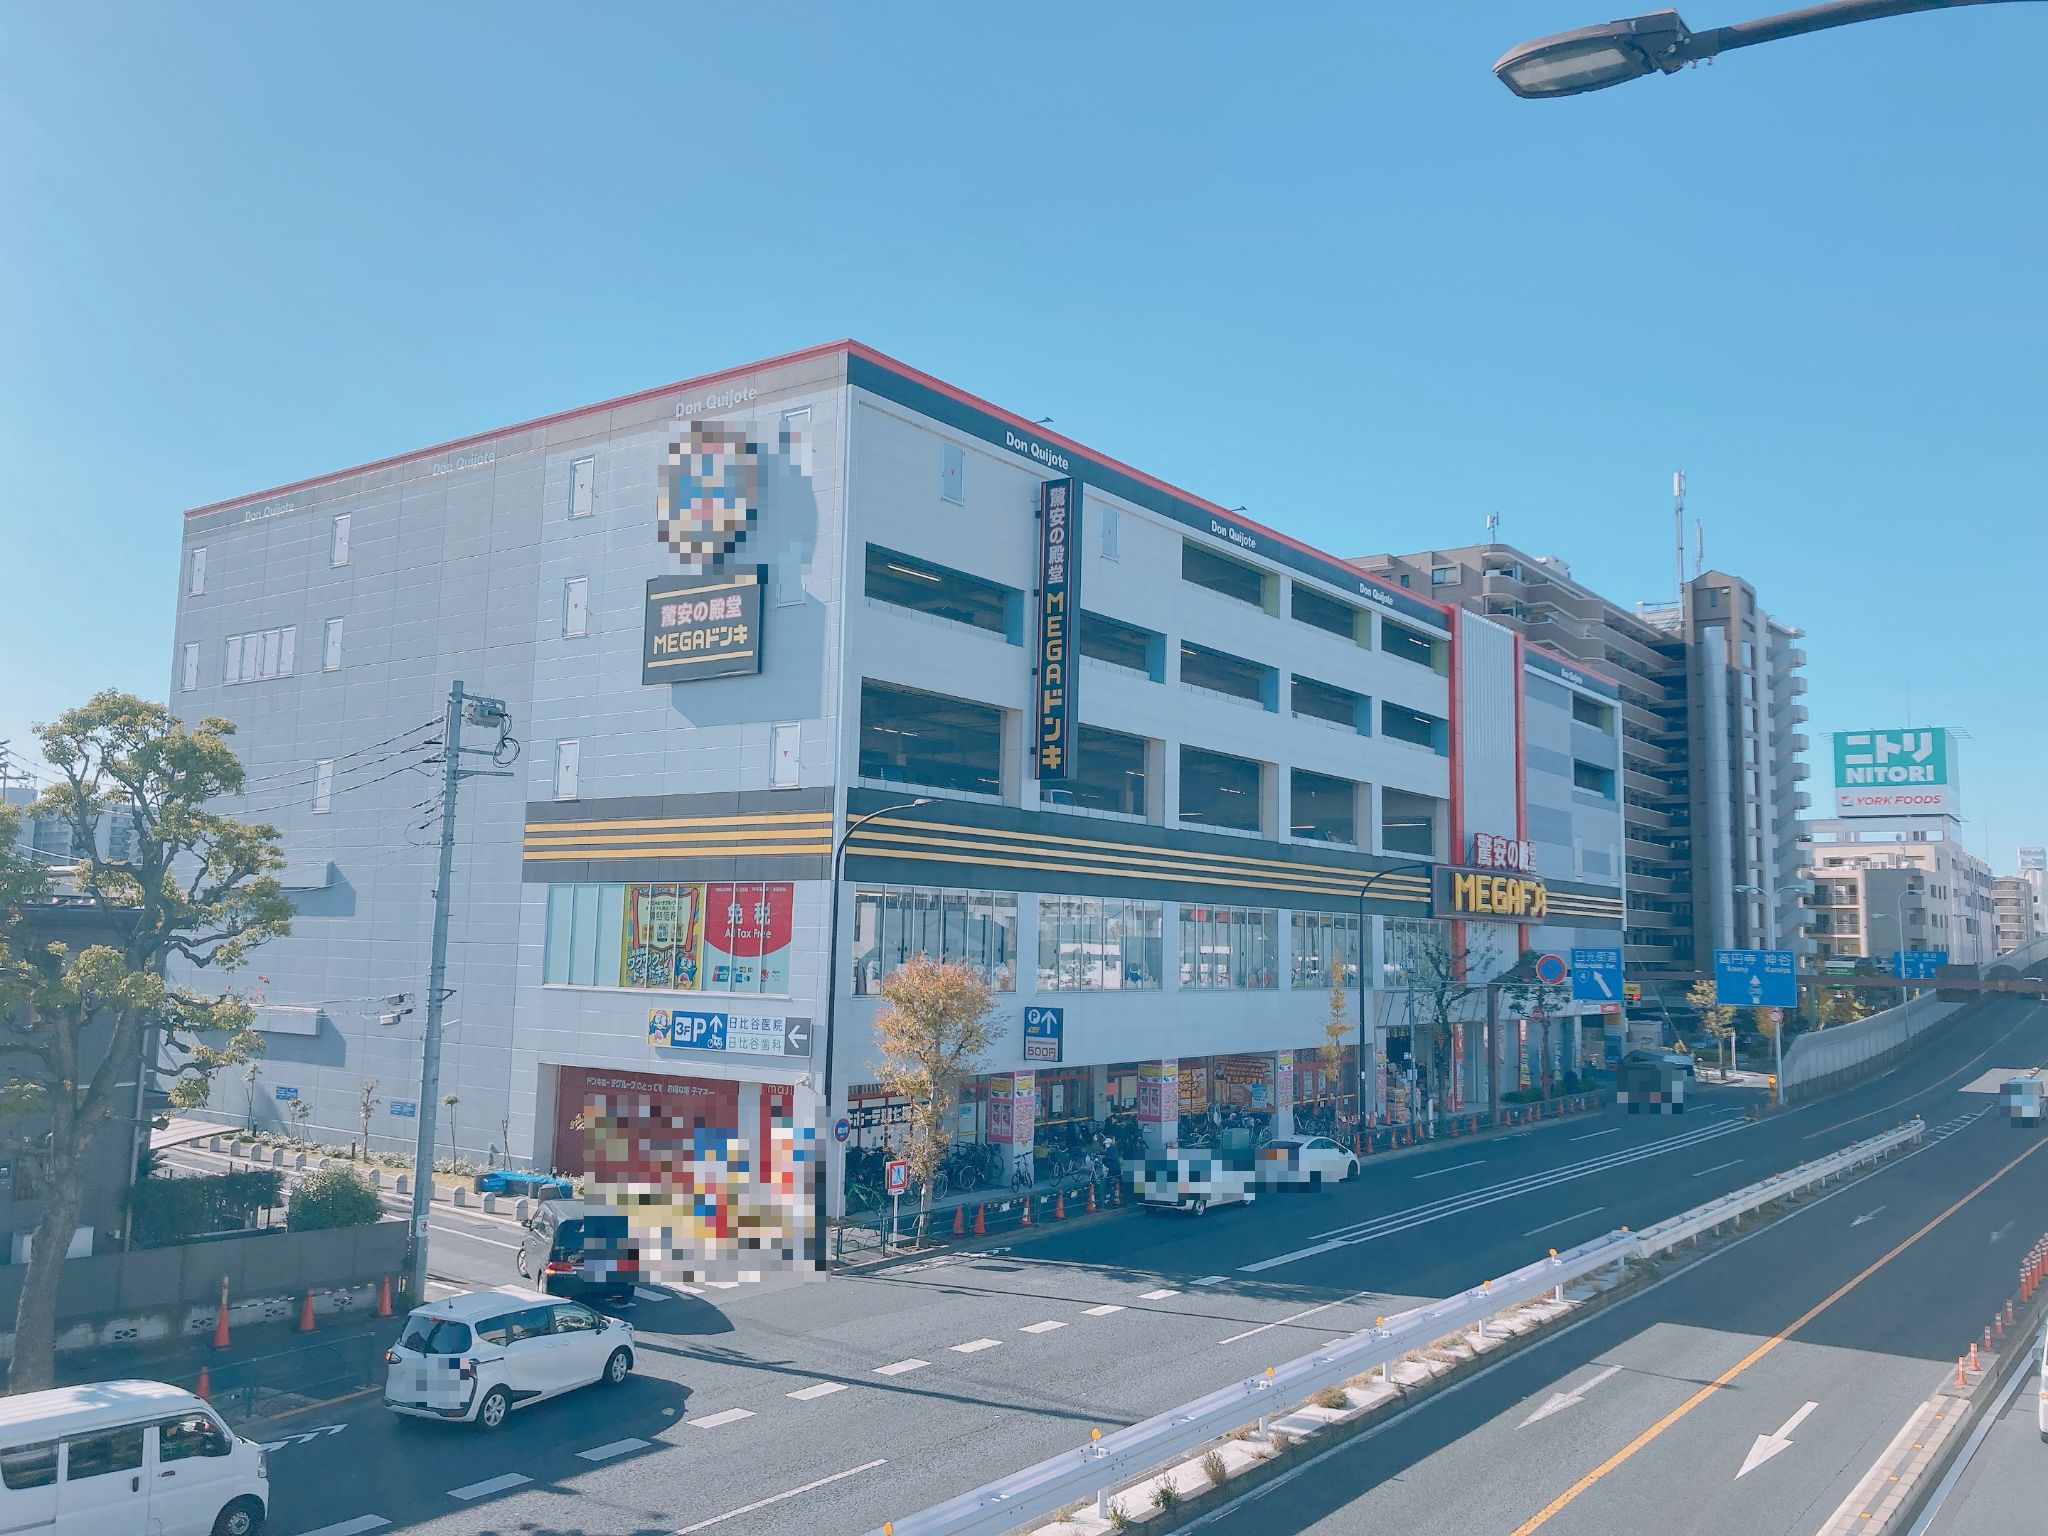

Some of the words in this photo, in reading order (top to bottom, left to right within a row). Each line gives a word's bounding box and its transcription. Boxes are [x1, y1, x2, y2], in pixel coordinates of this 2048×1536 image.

[675, 402, 702, 418] Don
[706, 387, 758, 409] Quijote
[1006, 431, 1028, 453] Don
[1031, 443, 1070, 470] Quijote
[1048, 486, 1067, 584] 驚安の殿堂
[1211, 519, 1227, 537] Don
[1229, 528, 1257, 549] Quijote
[661, 595, 743, 628] 驚安の殿堂
[653, 624, 748, 656] MEGAドンキ
[1042, 592, 1064, 769] MEGAドンキ
[1846, 731, 1934, 764] ニトリ
[1846, 764, 1935, 784] NITORI
[1857, 796, 1893, 806] YORK
[1894, 795, 1942, 805] FOODS
[737, 928, 752, 939] Tax
[676, 1022, 691, 1037] 3F
[692, 1018, 707, 1043] P
[728, 1016, 783, 1032] 日比谷医院
[728, 1036, 782, 1052] 日比谷歯科
[1027, 1046, 1057, 1058] 500円
